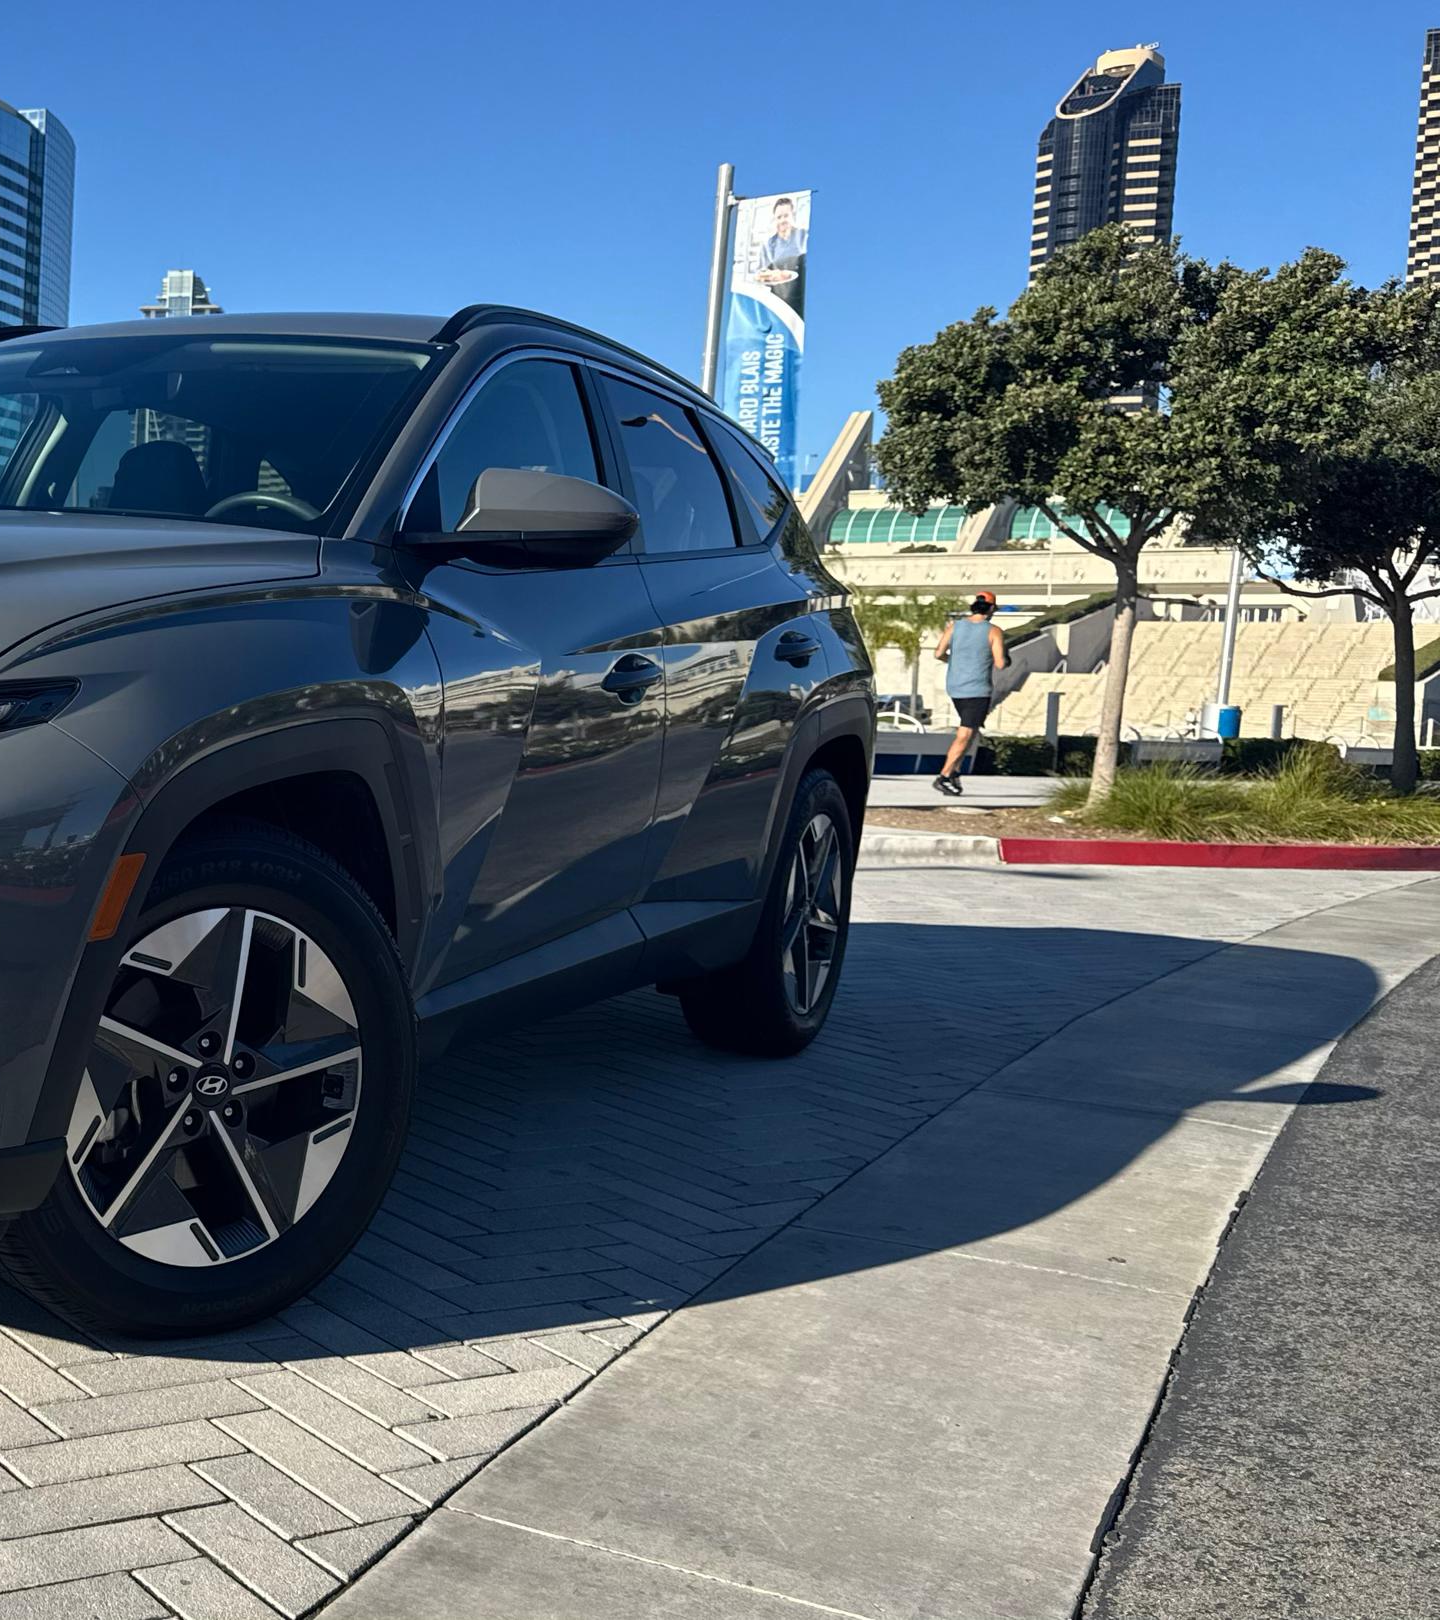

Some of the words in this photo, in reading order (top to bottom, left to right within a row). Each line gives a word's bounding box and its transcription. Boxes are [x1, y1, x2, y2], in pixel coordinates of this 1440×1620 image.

[739, 351, 761, 393] BLAIS
[763, 333, 785, 384] MAGIC
[762, 386, 783, 417] THE
